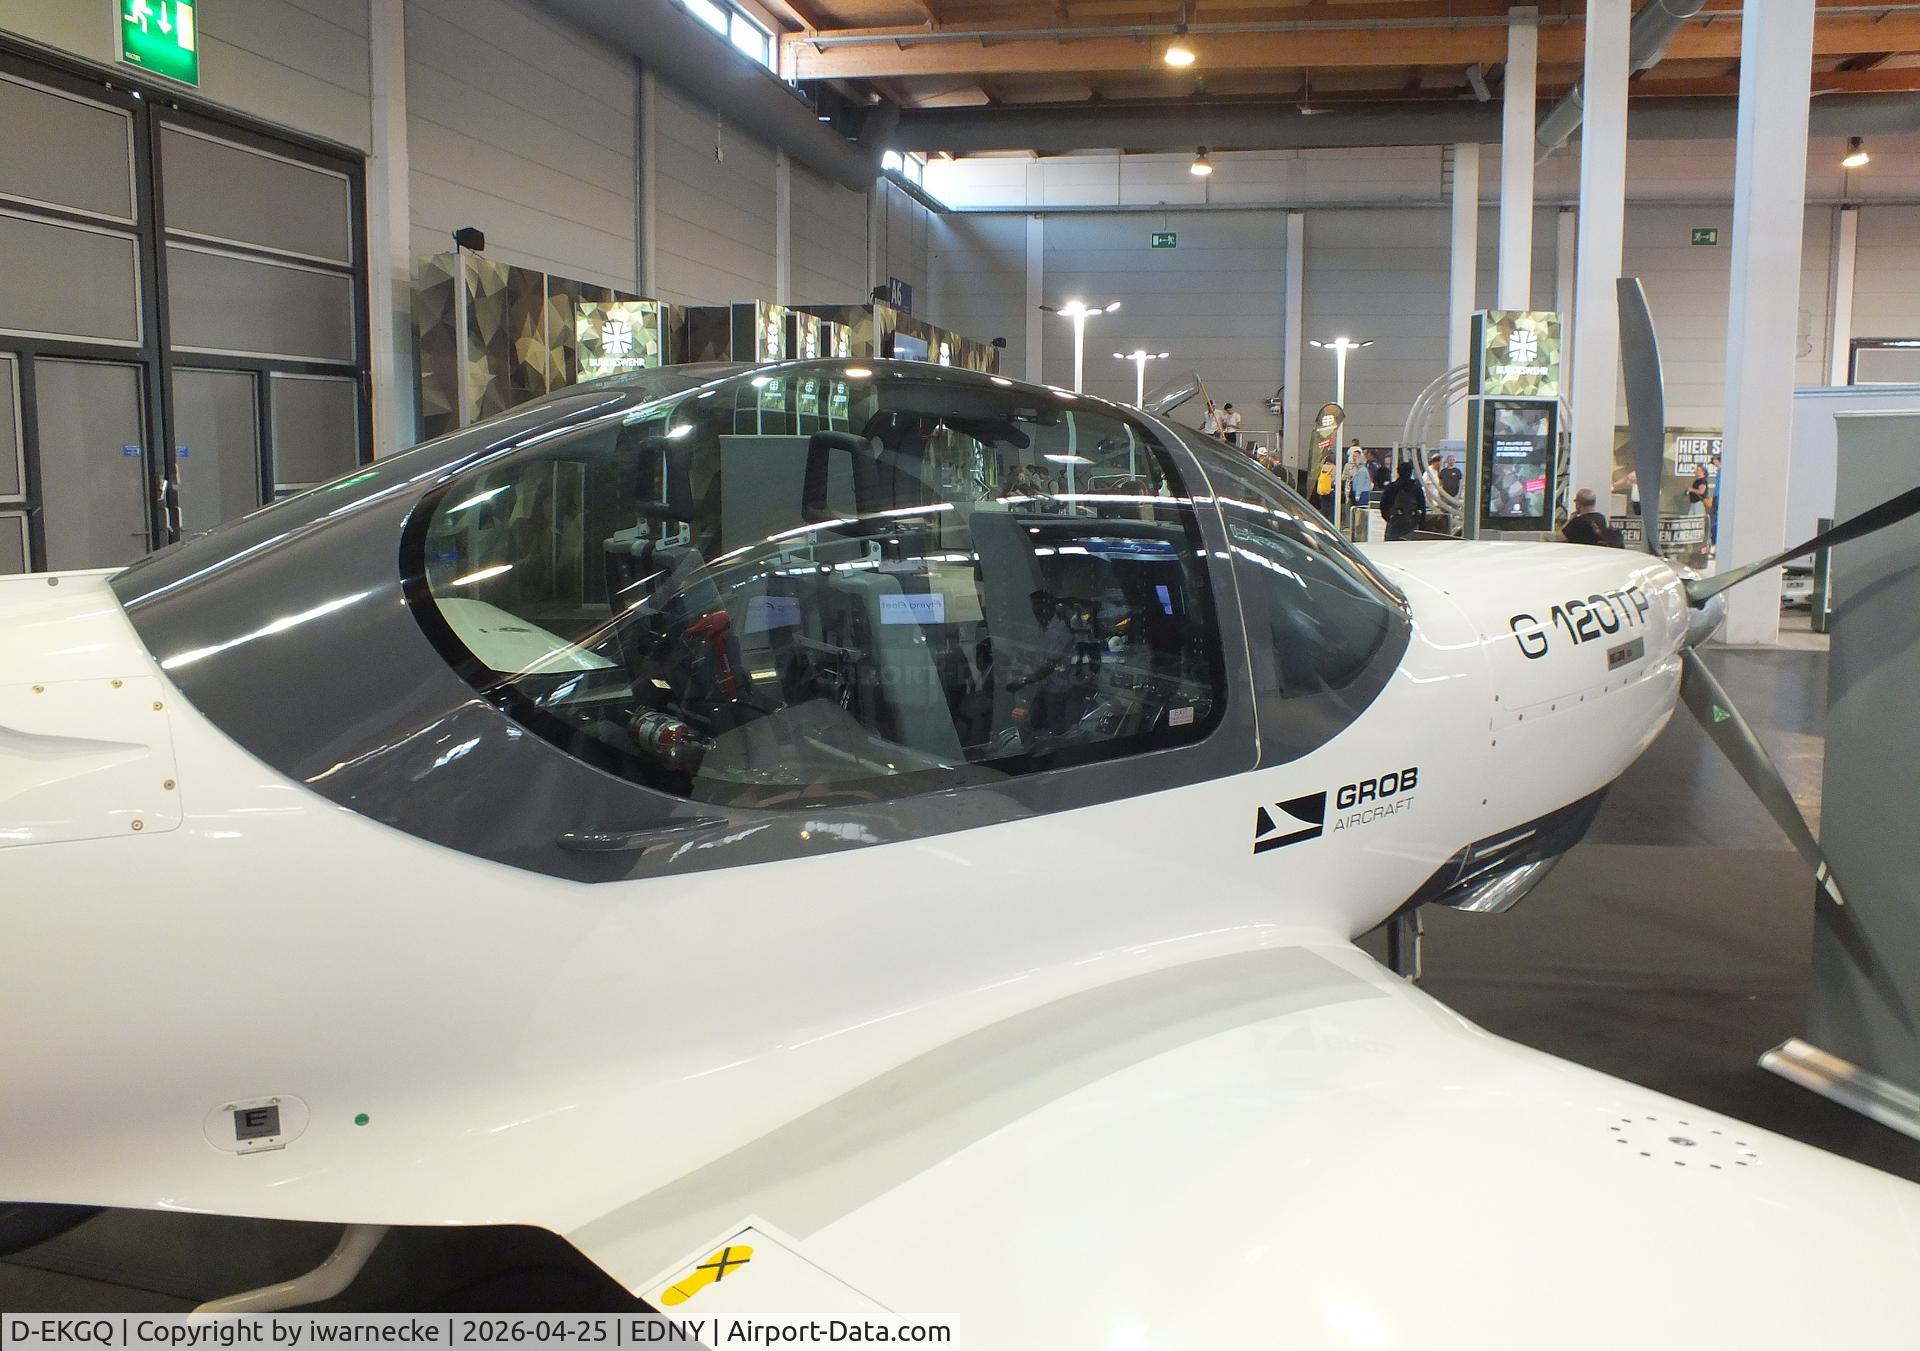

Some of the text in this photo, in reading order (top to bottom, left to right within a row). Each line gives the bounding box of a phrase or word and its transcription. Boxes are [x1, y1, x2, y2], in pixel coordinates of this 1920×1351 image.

[892, 280, 902, 306] A6
[1679, 440, 1708, 454] HIER
[1509, 585, 1649, 660] G 120TP
[1336, 766, 1418, 810] GROB
[1333, 797, 1414, 832] AIRCRAFT
[246, 1110, 268, 1127] E
